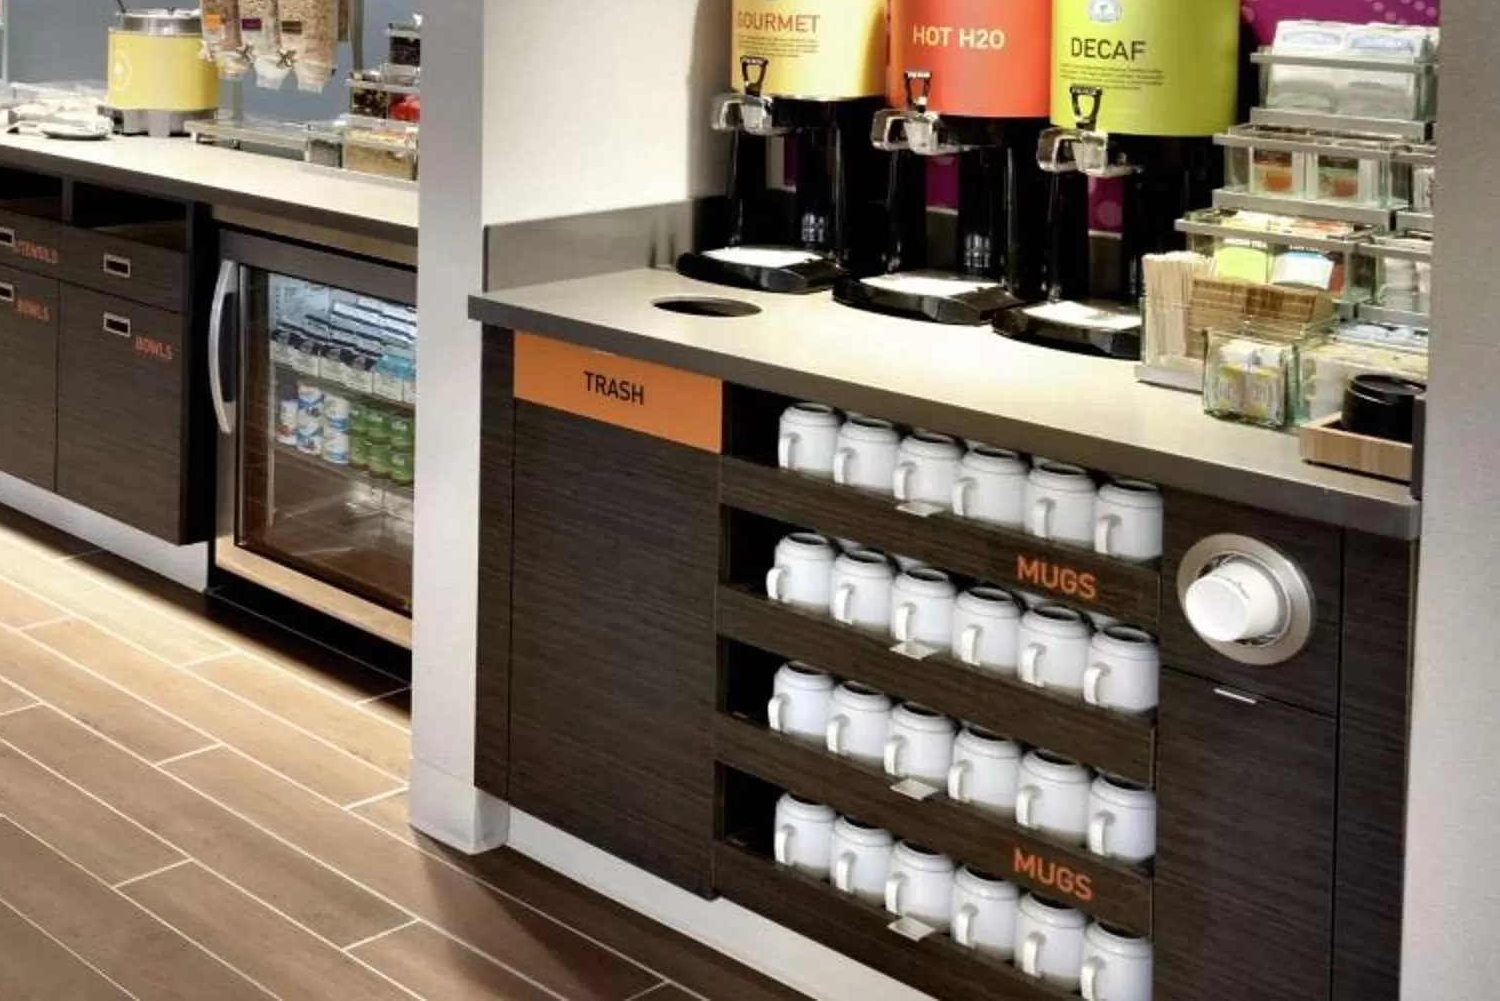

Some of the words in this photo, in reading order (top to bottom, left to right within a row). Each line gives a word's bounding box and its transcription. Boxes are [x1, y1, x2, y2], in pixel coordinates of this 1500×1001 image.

[913, 26, 952, 48] HOT
[959, 27, 1005, 50] H2O
[1071, 37, 1146, 61] DECAF
[583, 370, 645, 406] TRASH
[1016, 554, 1097, 599] MUGS
[1012, 847, 1094, 901] MUGS
